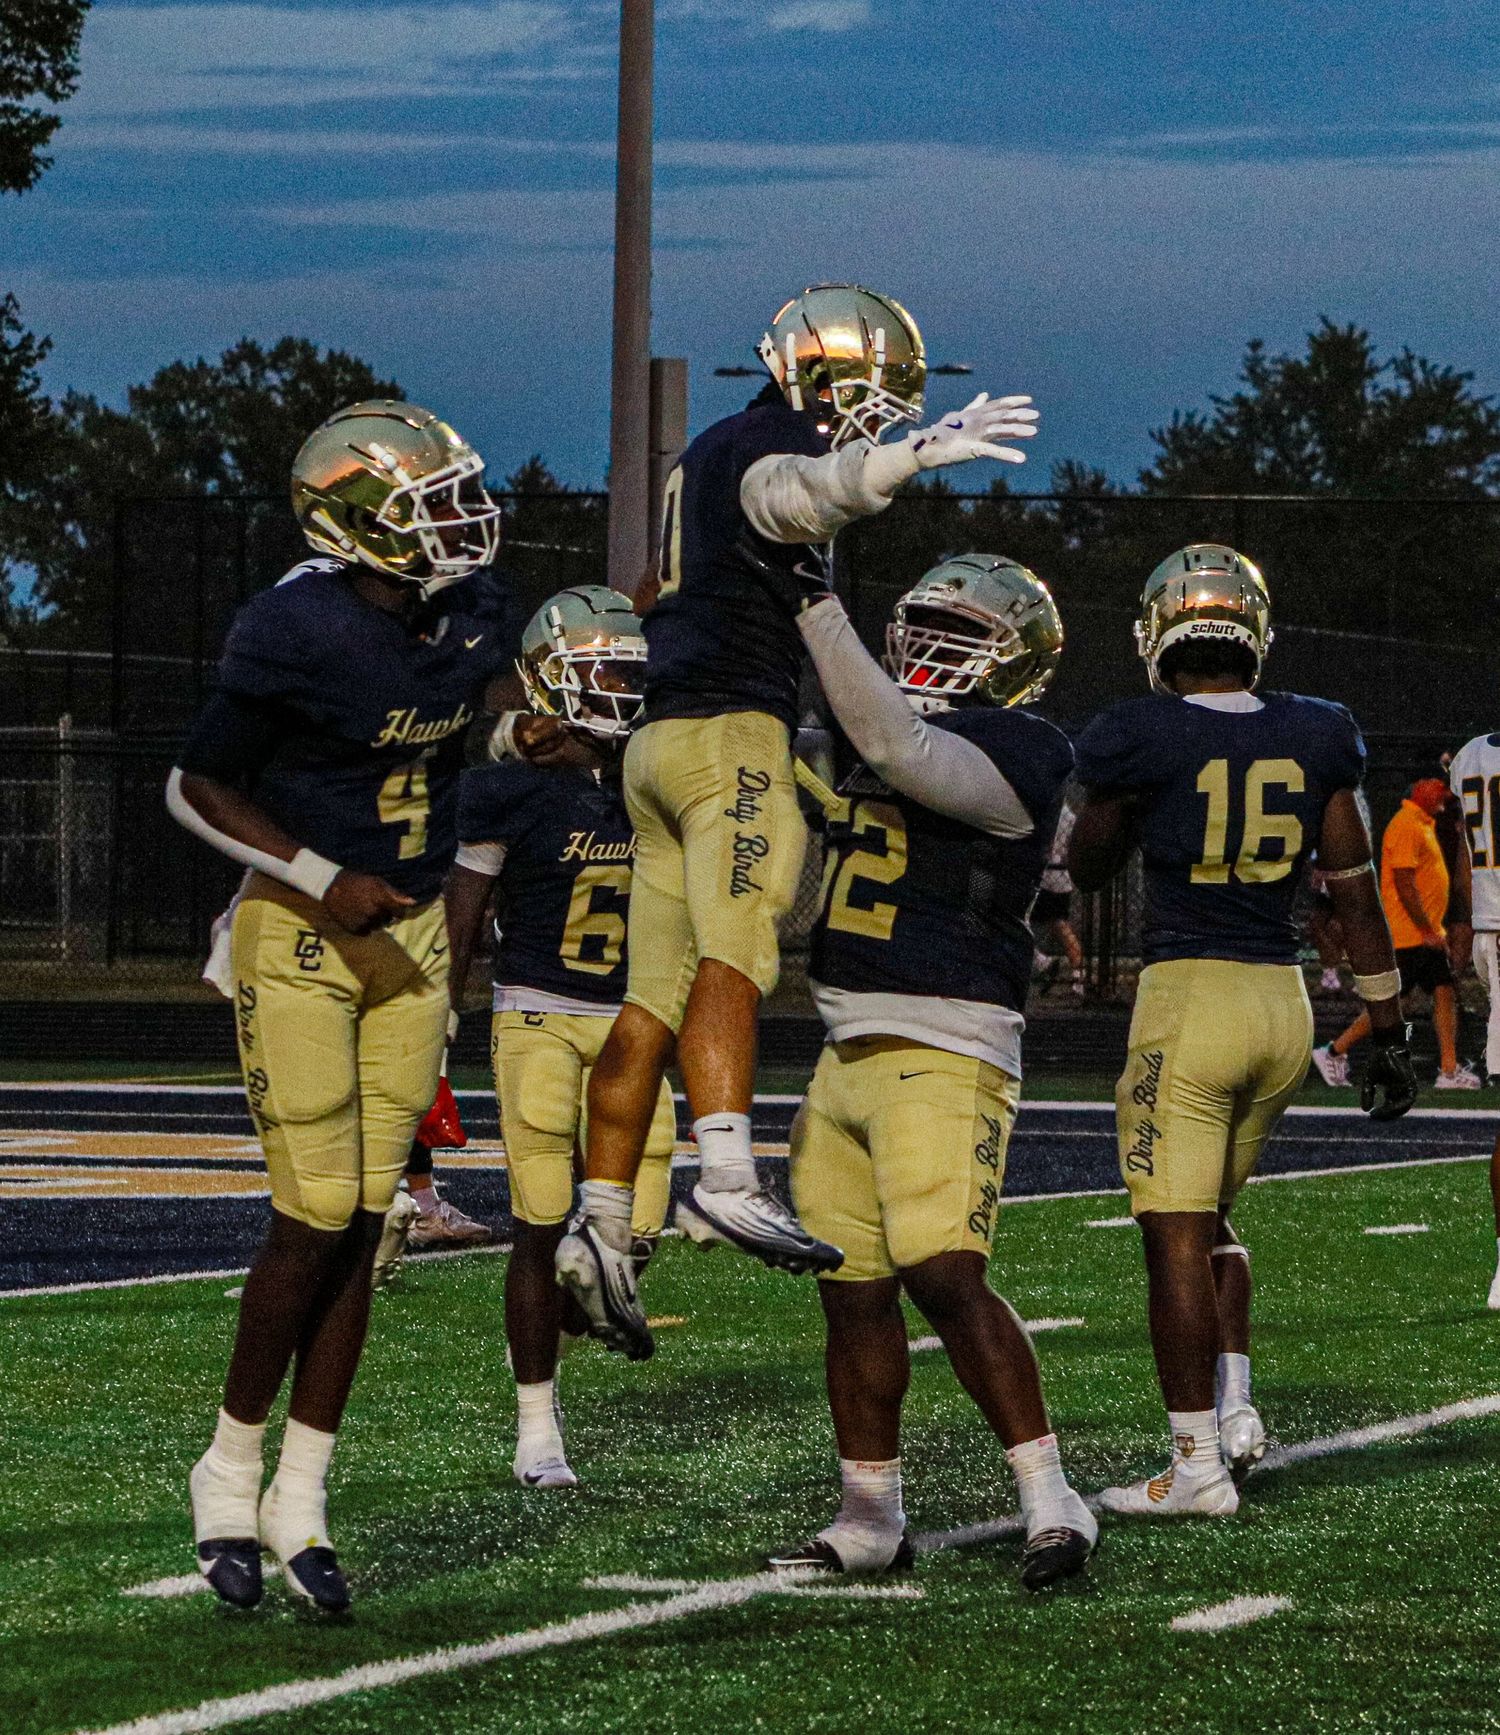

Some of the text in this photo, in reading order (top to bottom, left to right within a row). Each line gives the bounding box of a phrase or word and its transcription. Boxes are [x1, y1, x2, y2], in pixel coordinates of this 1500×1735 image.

[1190, 621, 1236, 635] schutt
[377, 752, 435, 860] 4
[558, 831, 639, 863] Hawk
[724, 766, 770, 898] Dirty Birds
[1190, 758, 1305, 884] 16
[559, 864, 633, 977] 6
[1126, 1050, 1163, 1176] Dirty Birds
[969, 1179, 998, 1242] Dirty
